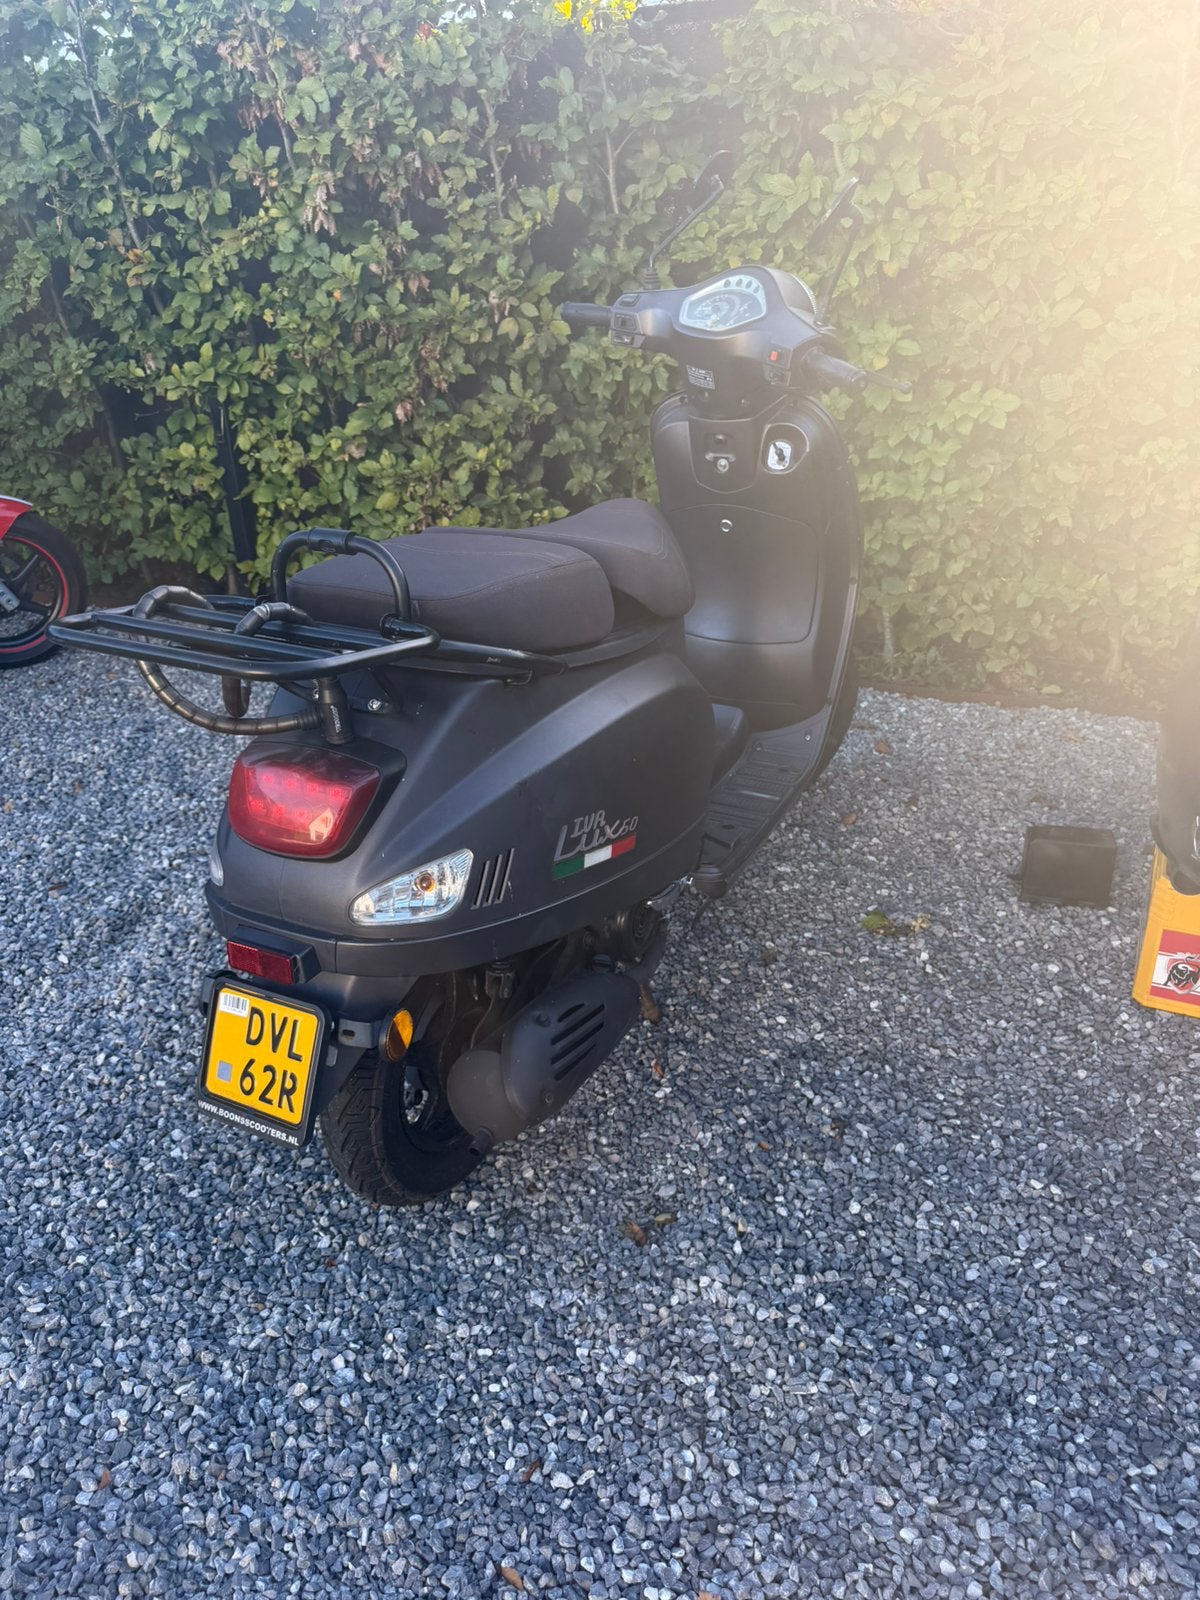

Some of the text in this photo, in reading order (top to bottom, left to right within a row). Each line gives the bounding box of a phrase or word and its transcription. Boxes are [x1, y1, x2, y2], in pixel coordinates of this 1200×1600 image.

[570, 809, 606, 838] IVA
[245, 1006, 303, 1062] DVL
[239, 1058, 299, 1113] 62R
[198, 1100, 300, 1146] WWW.BOONSSCOOTERS.NL
